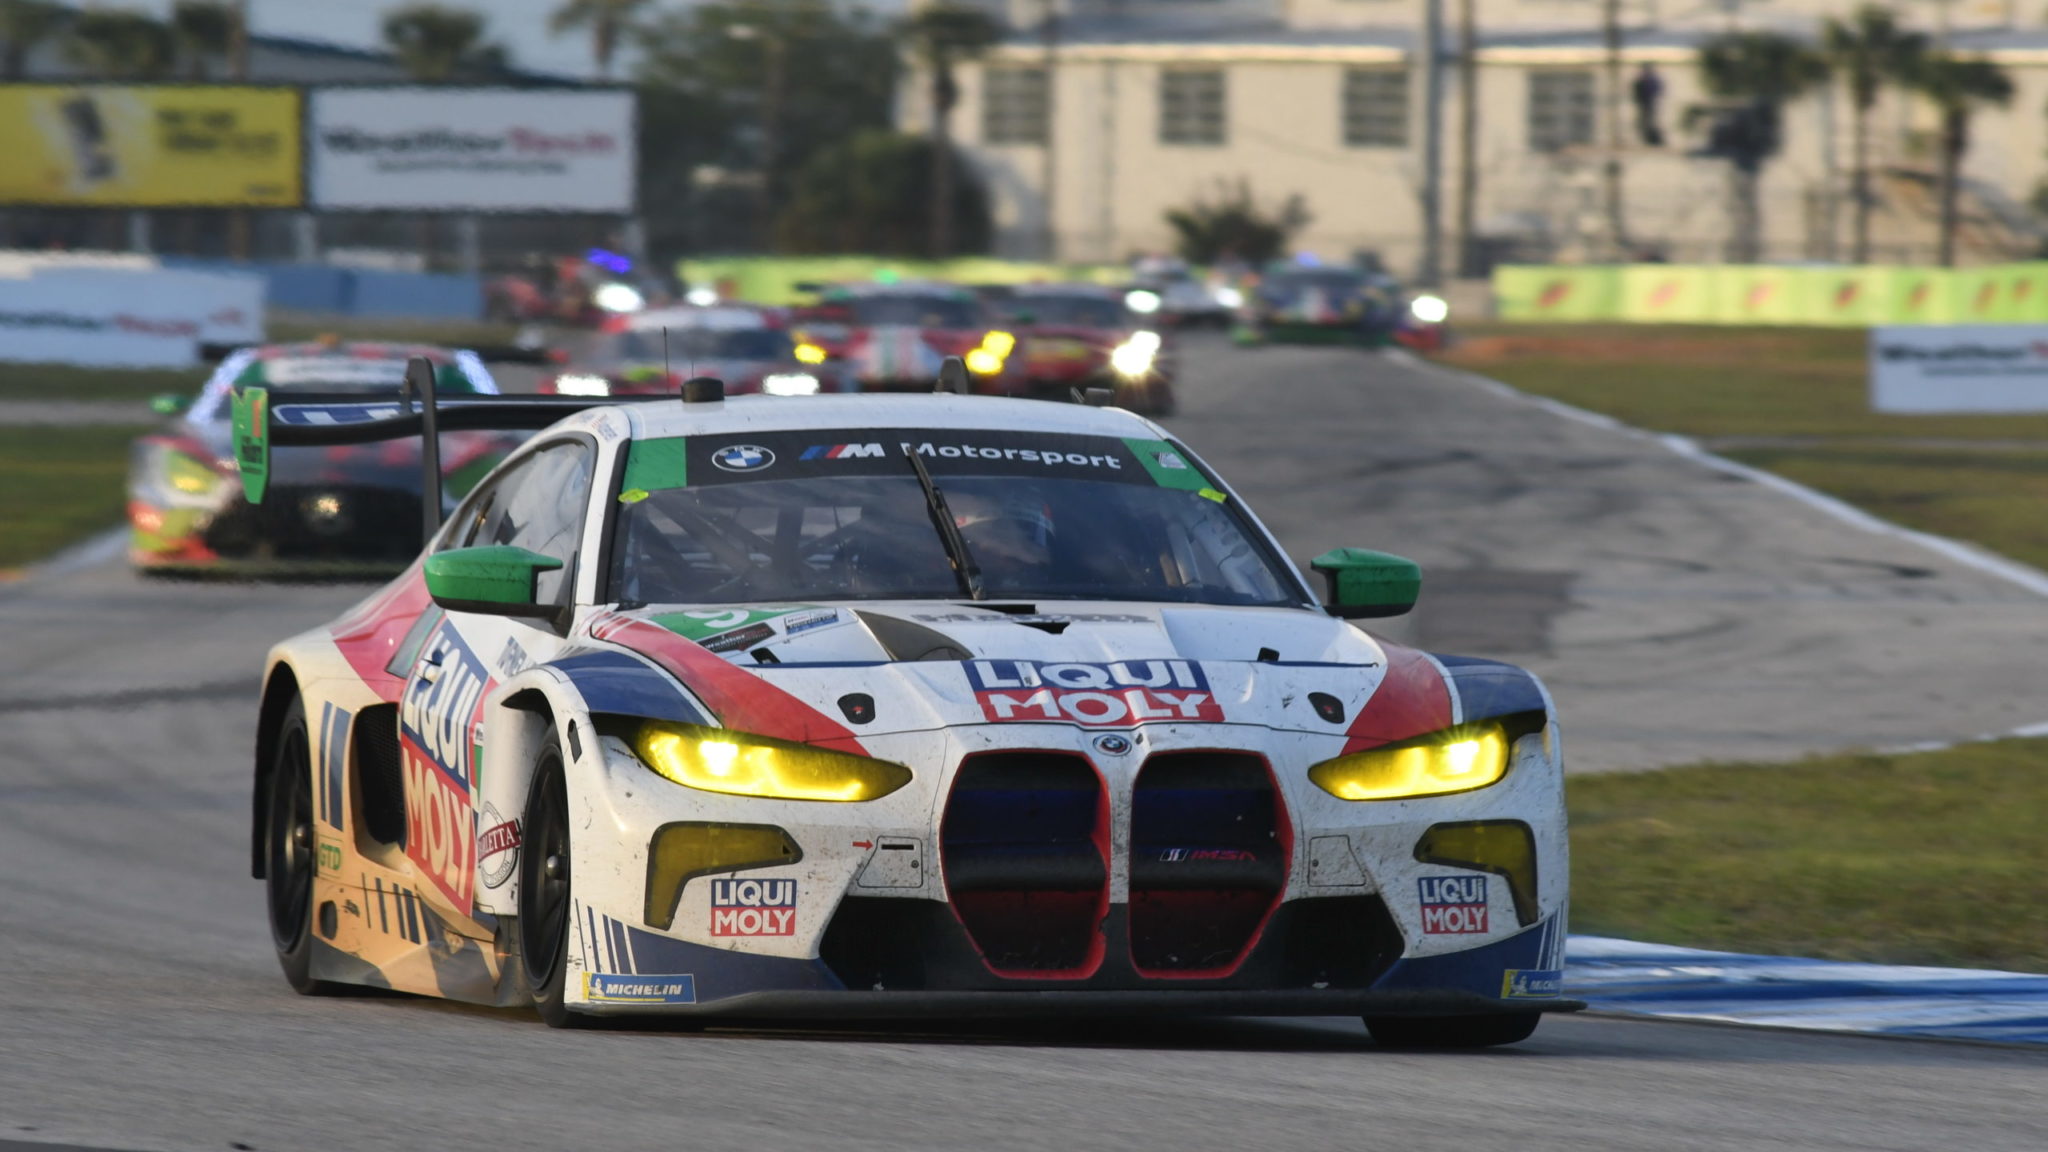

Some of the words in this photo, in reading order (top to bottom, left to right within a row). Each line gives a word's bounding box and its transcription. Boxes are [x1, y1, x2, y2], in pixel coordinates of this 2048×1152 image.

[901, 441, 1122, 470] Motorsport
[972, 659, 1197, 689] LIQUI
[988, 687, 1210, 724] MOLY
[403, 746, 470, 901] MOLY
[319, 843, 341, 870] GTD
[715, 880, 793, 907] LIQUI
[1420, 878, 1485, 904] LIQUI
[714, 908, 795, 935] MOLY
[1423, 906, 1487, 932] MOLY
[605, 982, 683, 996] MICHELIN
